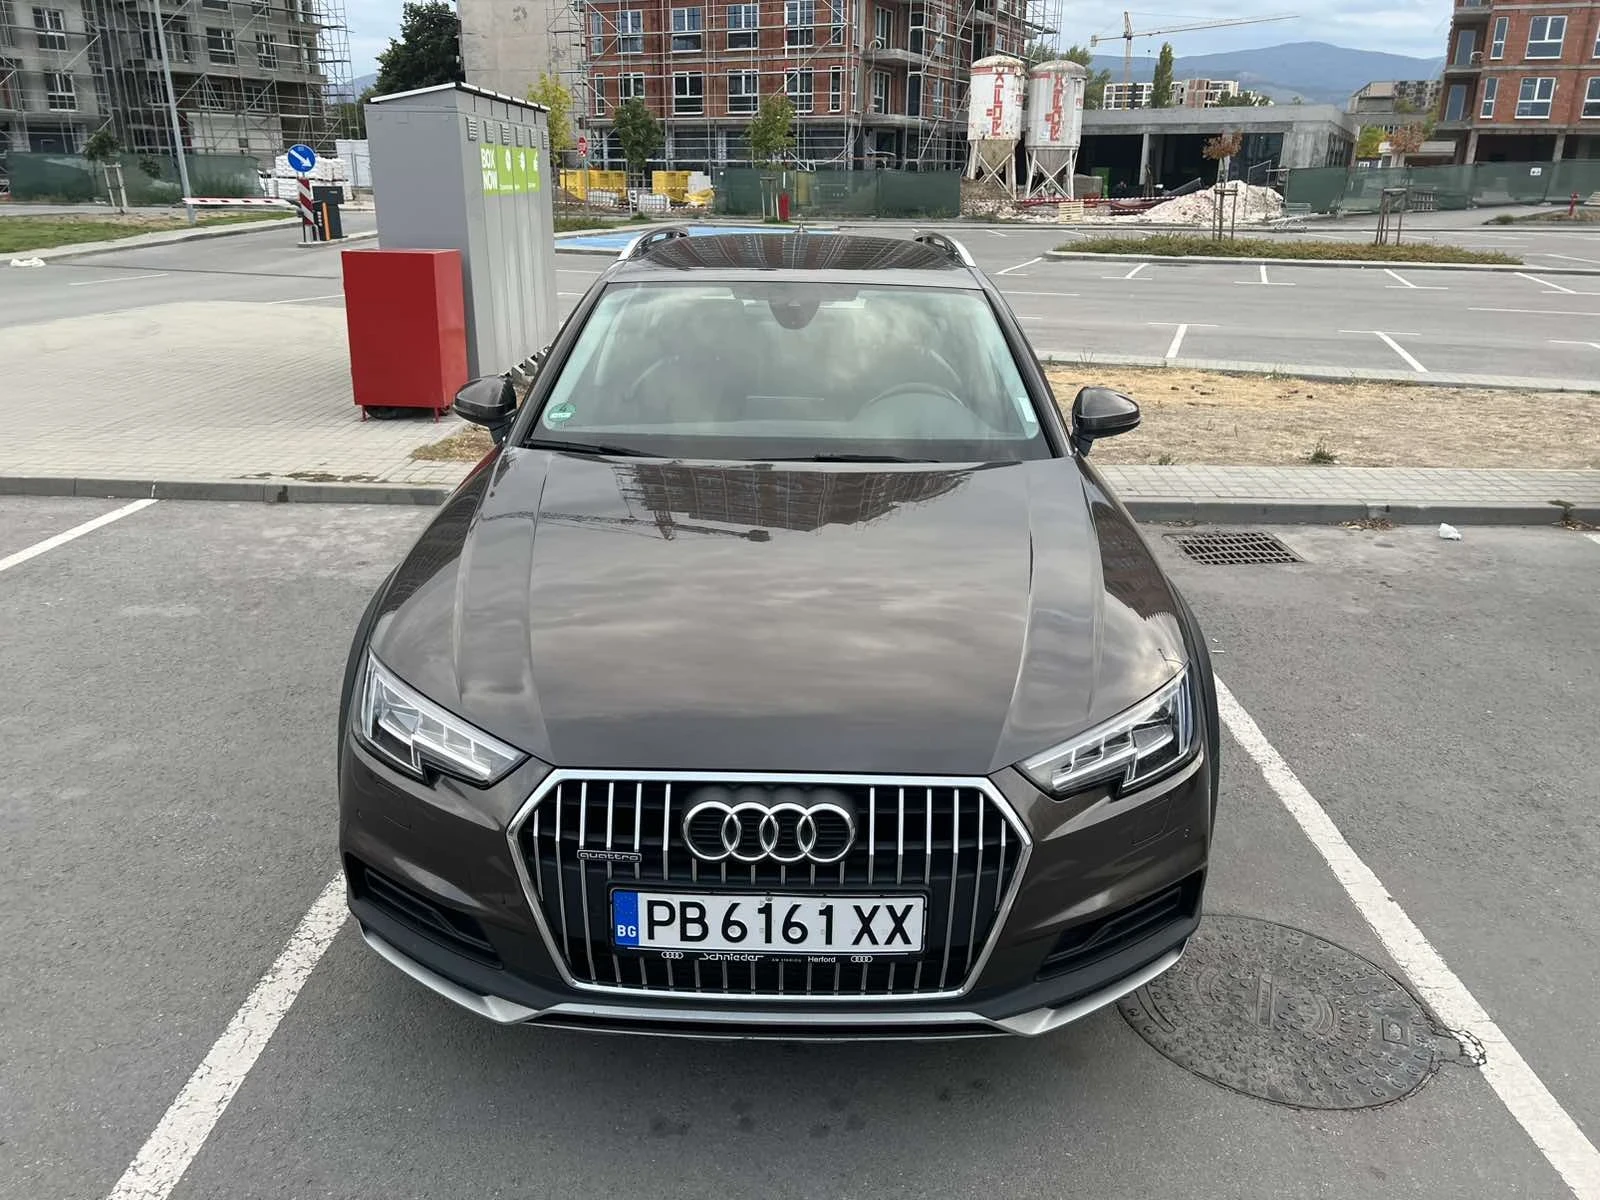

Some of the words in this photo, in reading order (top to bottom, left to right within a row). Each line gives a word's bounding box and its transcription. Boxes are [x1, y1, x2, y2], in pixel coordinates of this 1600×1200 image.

[986, 66, 1005, 136] RÖFIX
[480, 148, 496, 169] BOX
[482, 169, 498, 191] NOW
[580, 852, 639, 861] quattro
[617, 924, 637, 938] BG
[647, 899, 709, 942] PB
[721, 902, 834, 945] 6161
[851, 904, 914, 946] XX
[699, 952, 765, 962] Schnieder
[807, 955, 837, 963] Herford
